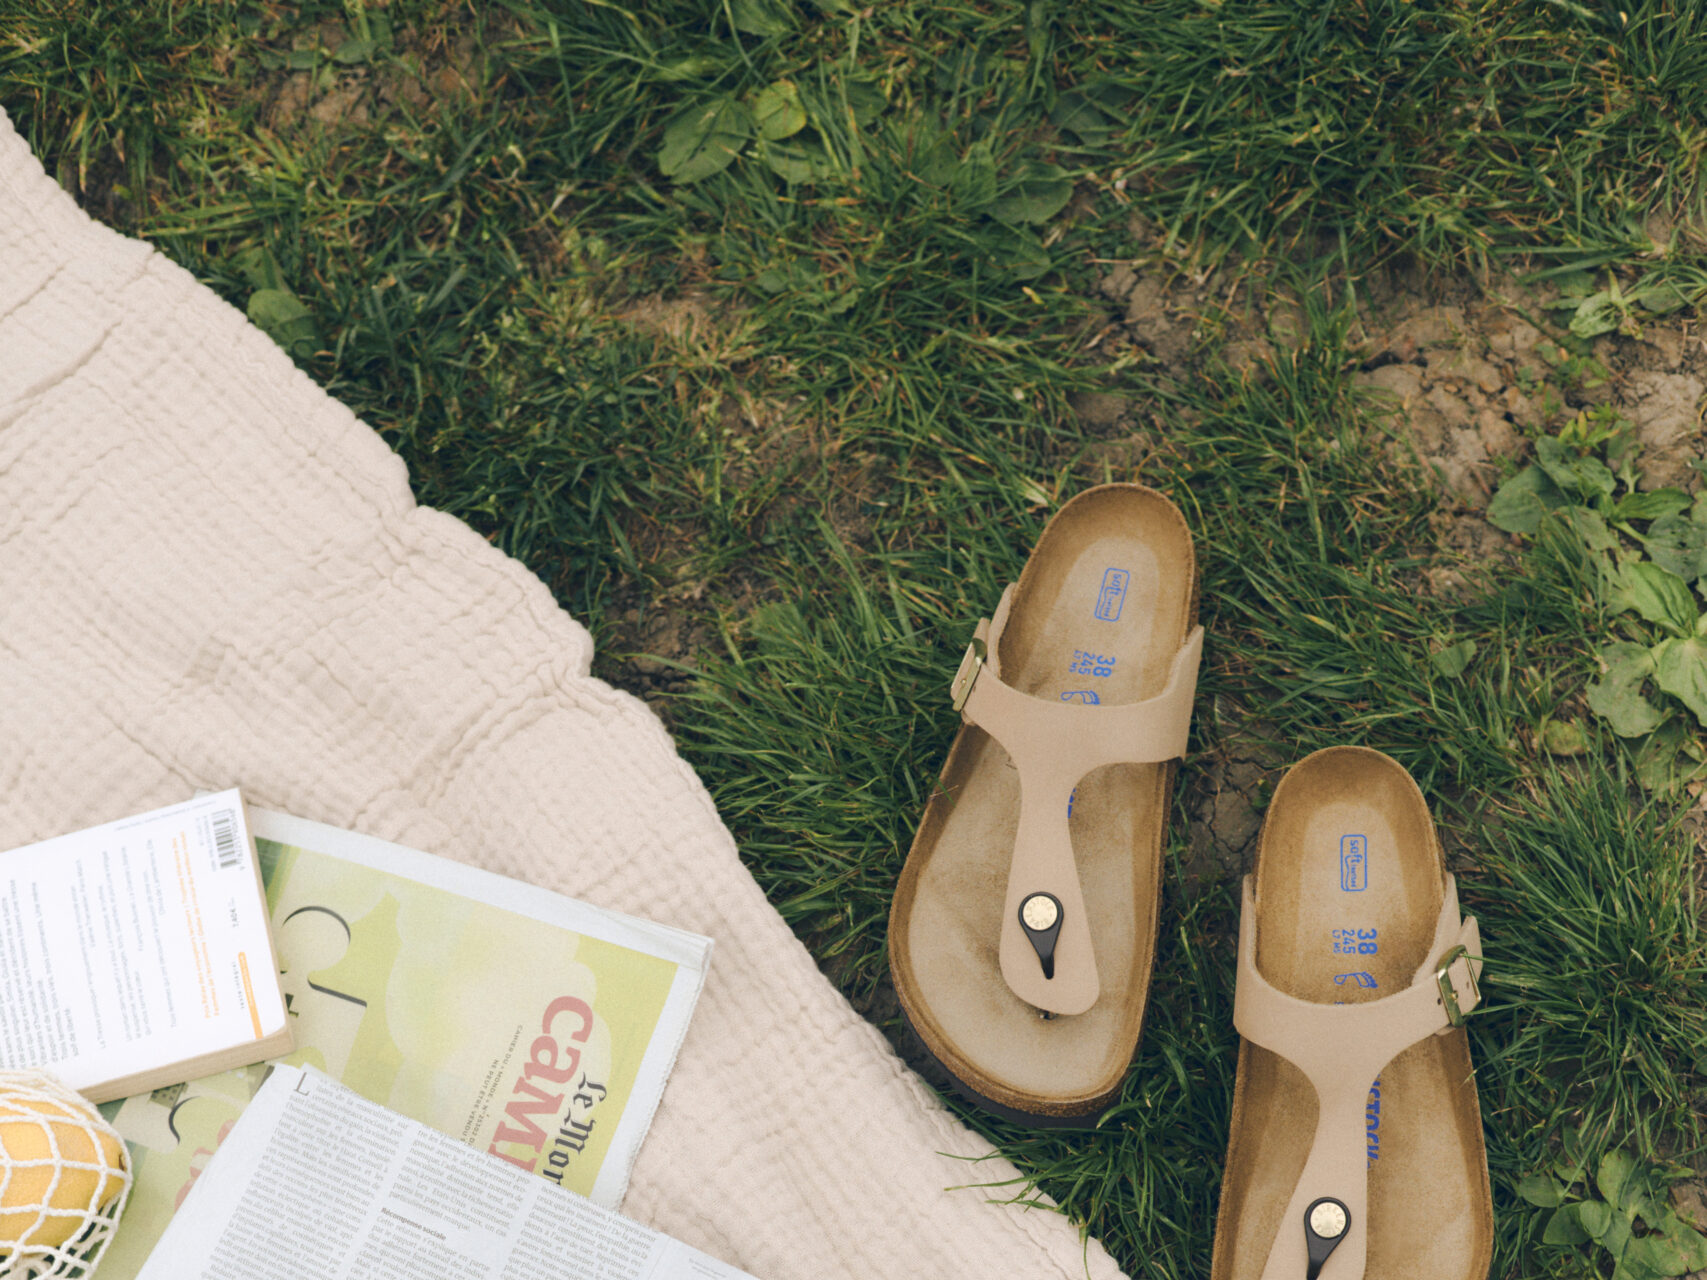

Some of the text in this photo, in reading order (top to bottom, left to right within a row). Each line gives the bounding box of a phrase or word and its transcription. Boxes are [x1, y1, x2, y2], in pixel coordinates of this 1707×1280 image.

[1109, 573, 1122, 595] soft
[1078, 651, 1094, 674] 245
[1092, 655, 1115, 677] 38
[1349, 839, 1362, 863] soft
[1342, 929, 1356, 953] 245
[1357, 928, 1378, 954] 38
[573, 1071, 607, 1109] Le
[381, 1207, 446, 1240] Récompense sociale
